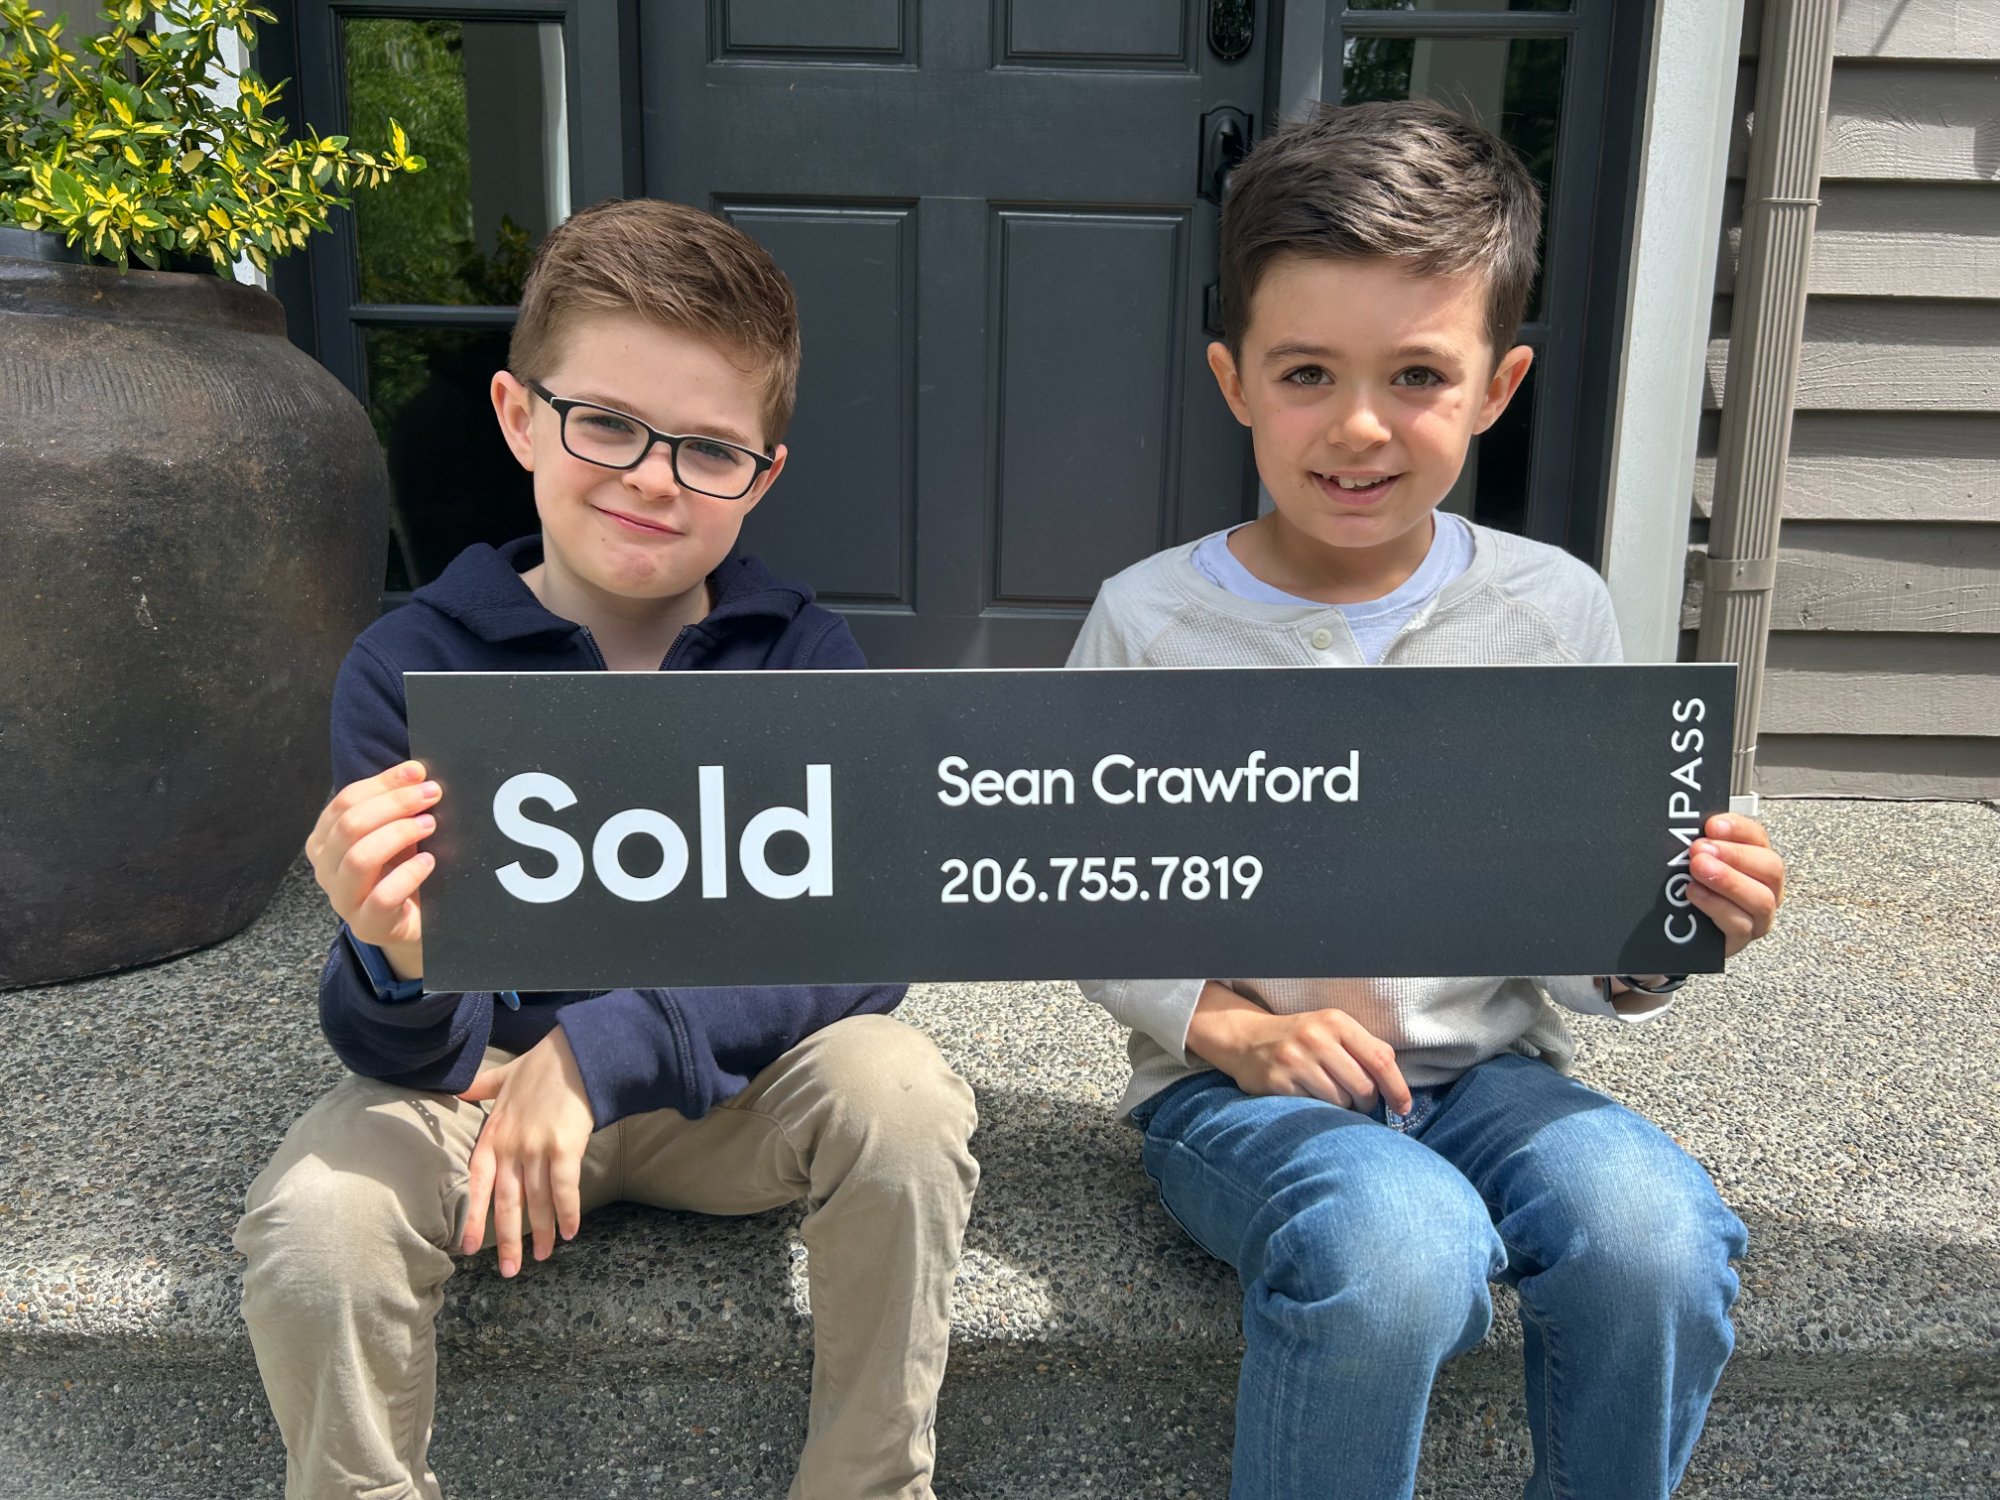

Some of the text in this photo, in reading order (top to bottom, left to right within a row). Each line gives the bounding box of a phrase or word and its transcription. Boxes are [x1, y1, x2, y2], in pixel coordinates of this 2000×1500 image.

[937, 749, 1361, 807] Sean Crawford
[1664, 697, 1706, 944] COMPASS
[492, 763, 834, 904] Sold
[940, 855, 1264, 904] 206.755.7819
